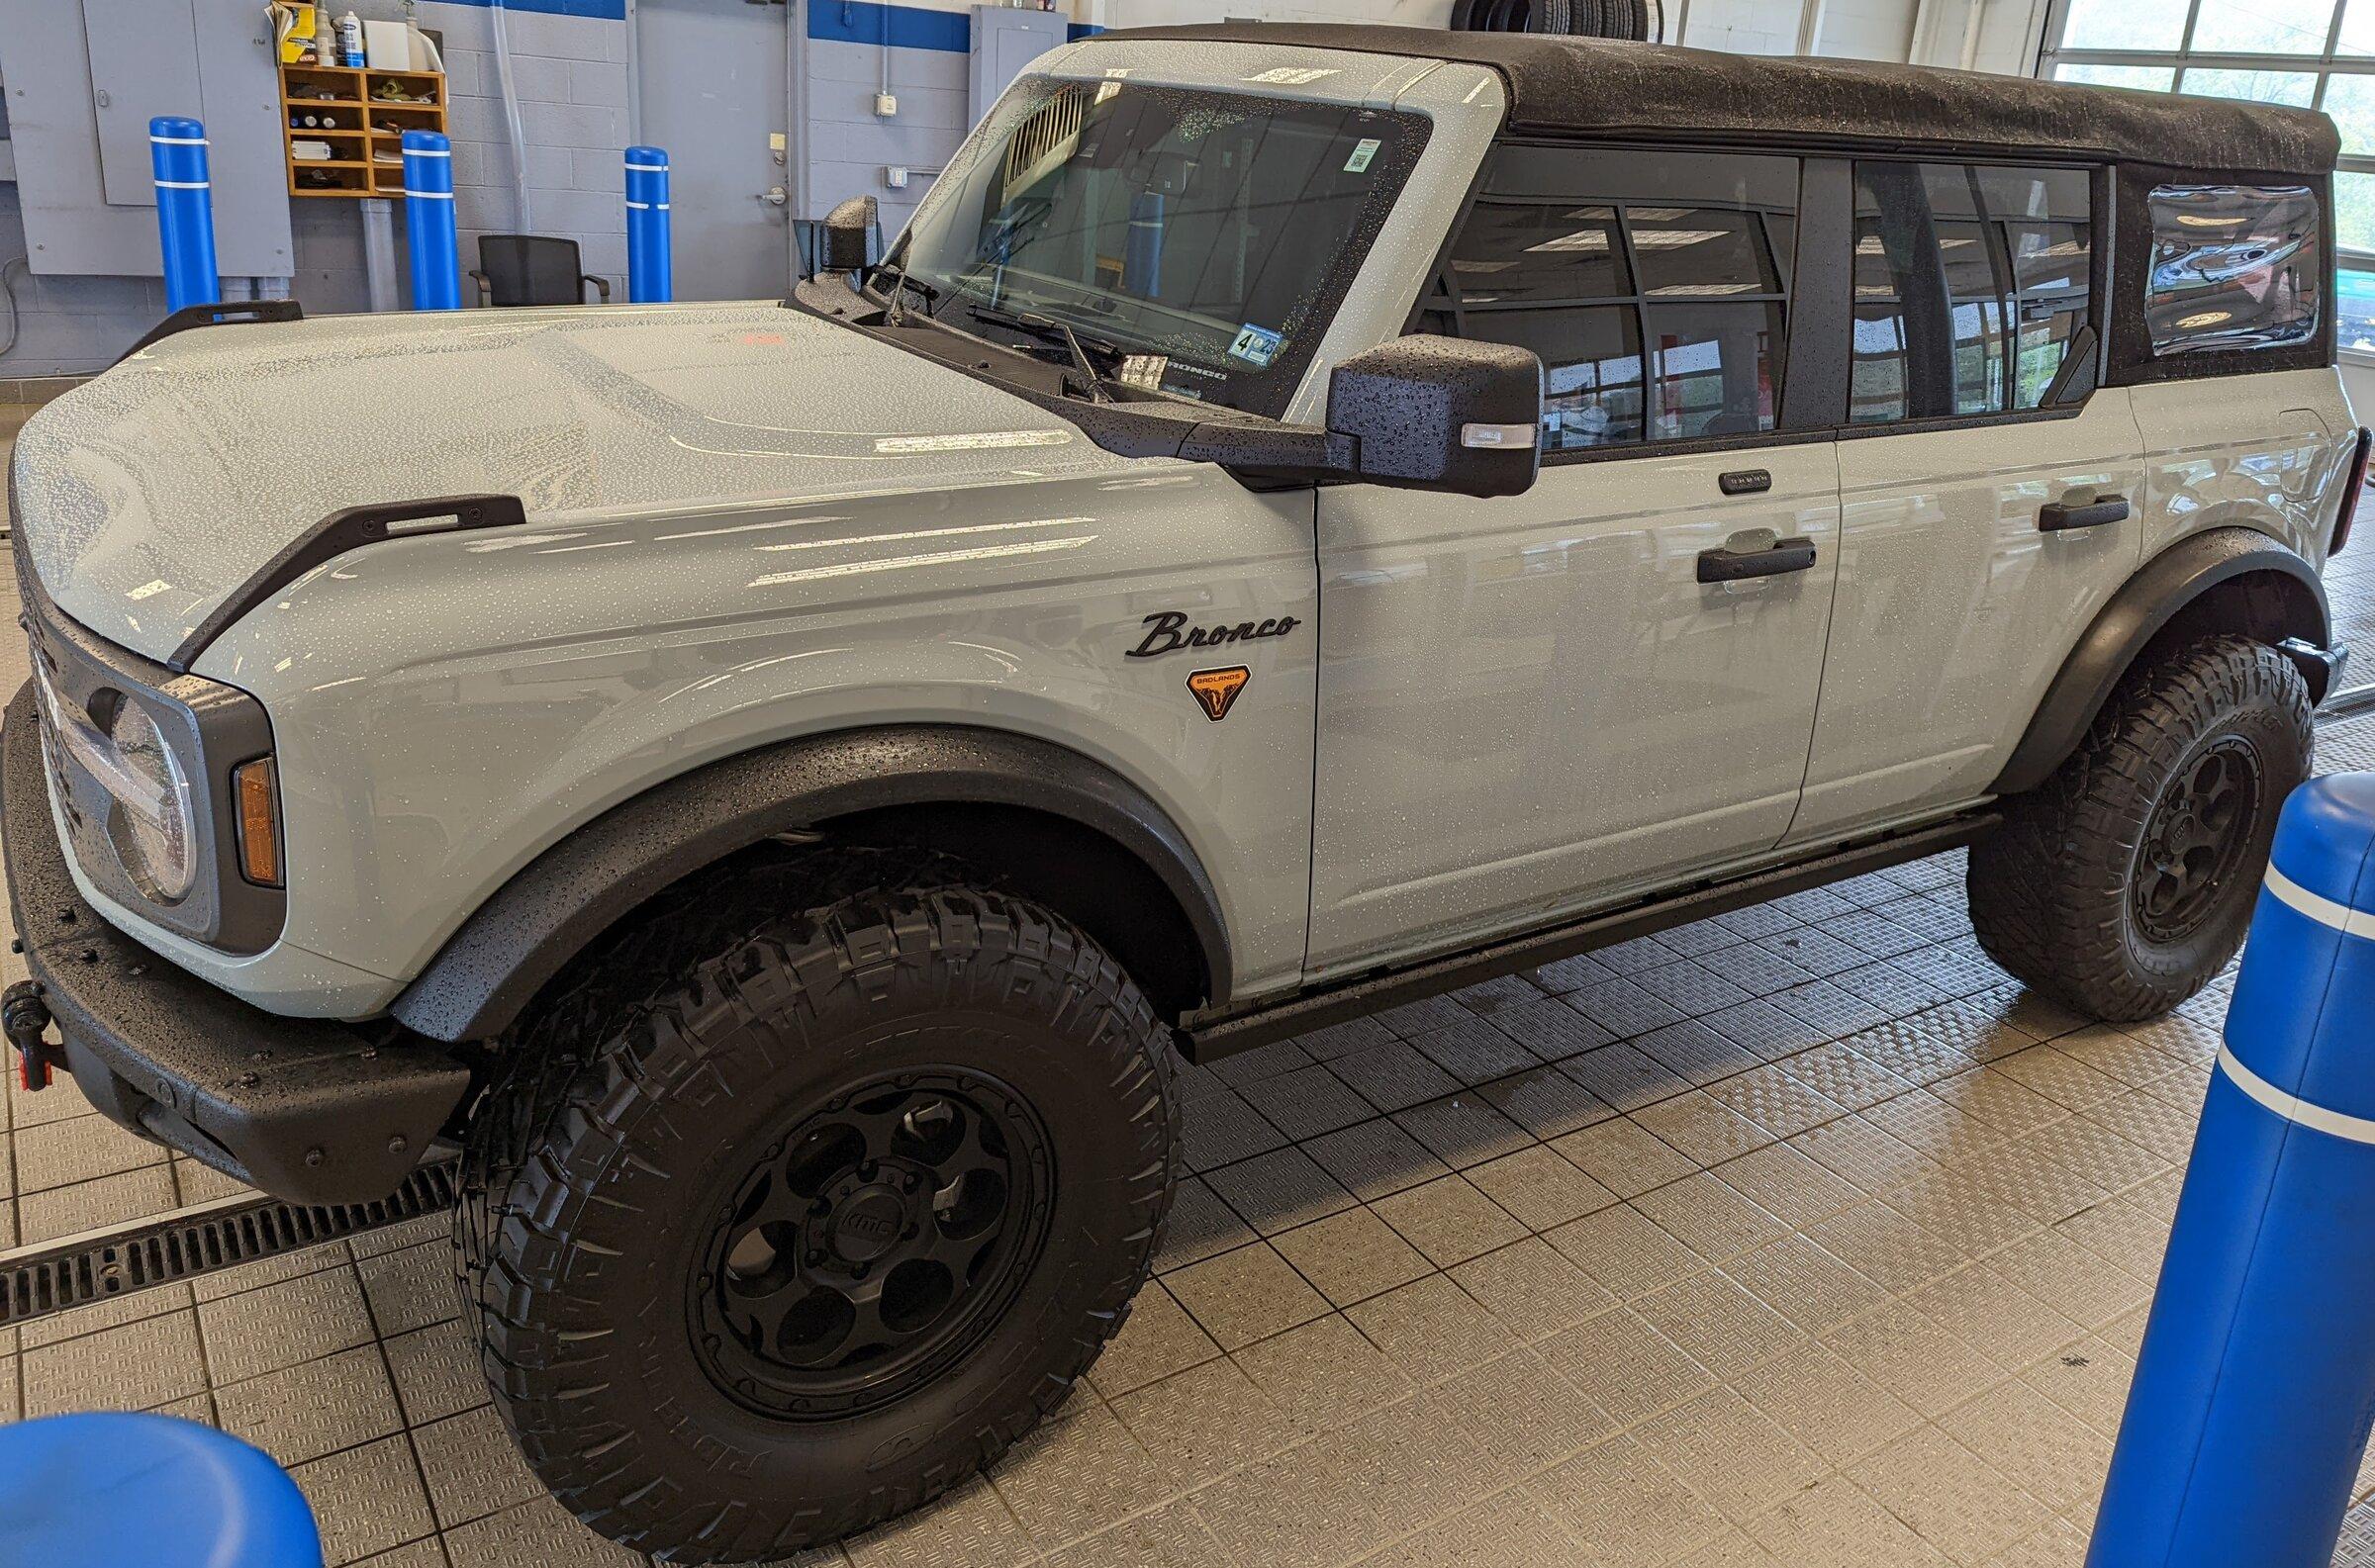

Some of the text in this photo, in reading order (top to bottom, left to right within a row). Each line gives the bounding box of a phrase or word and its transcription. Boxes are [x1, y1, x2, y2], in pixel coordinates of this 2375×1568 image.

[1237, 333, 1254, 351] 4
[1124, 610, 1302, 658] Bronco
[1196, 673, 1242, 685] BADLANDS
